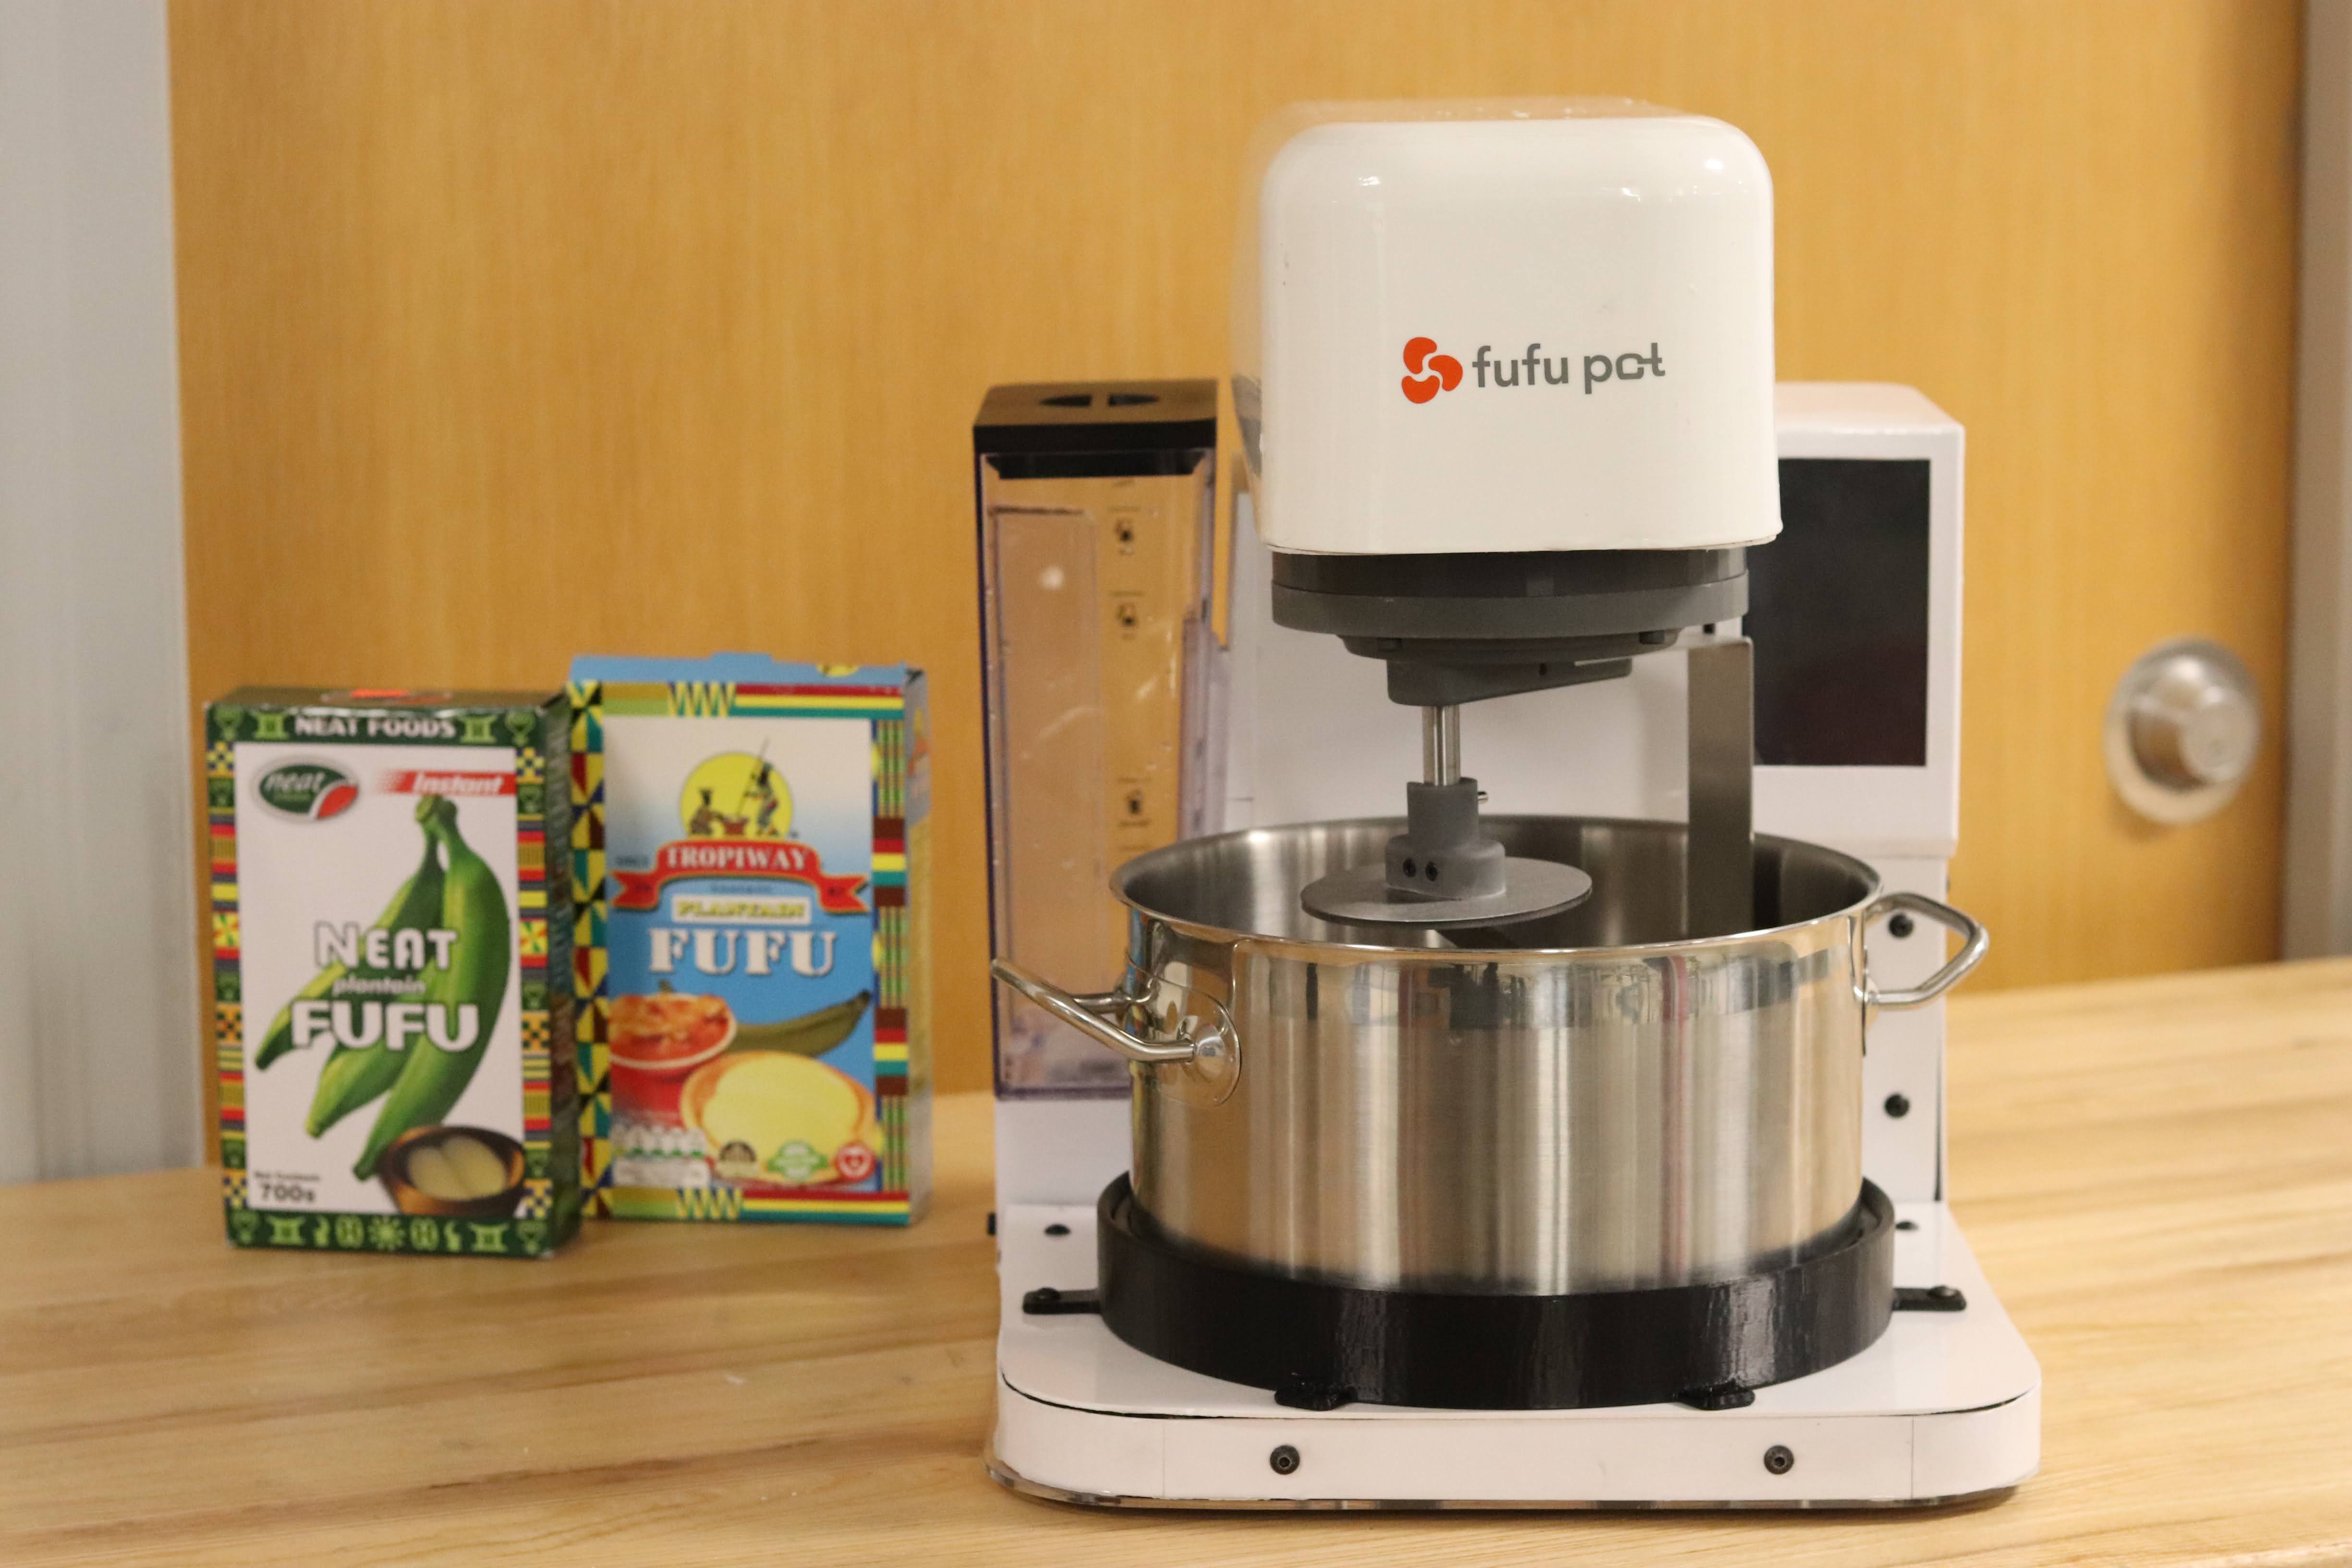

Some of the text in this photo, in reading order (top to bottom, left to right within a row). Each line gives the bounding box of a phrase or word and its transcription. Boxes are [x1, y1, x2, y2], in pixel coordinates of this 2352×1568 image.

[1472, 342, 1665, 394] fufu pot
[294, 717, 457, 738] NEAT FOODS
[265, 772, 326, 792] neat
[411, 771, 504, 794] Instant
[666, 845, 812, 871] TROPIWAY
[314, 920, 458, 971] NEAT
[648, 927, 838, 978] FUFU
[332, 973, 428, 997] plantain
[291, 1000, 480, 1052] FUFU
